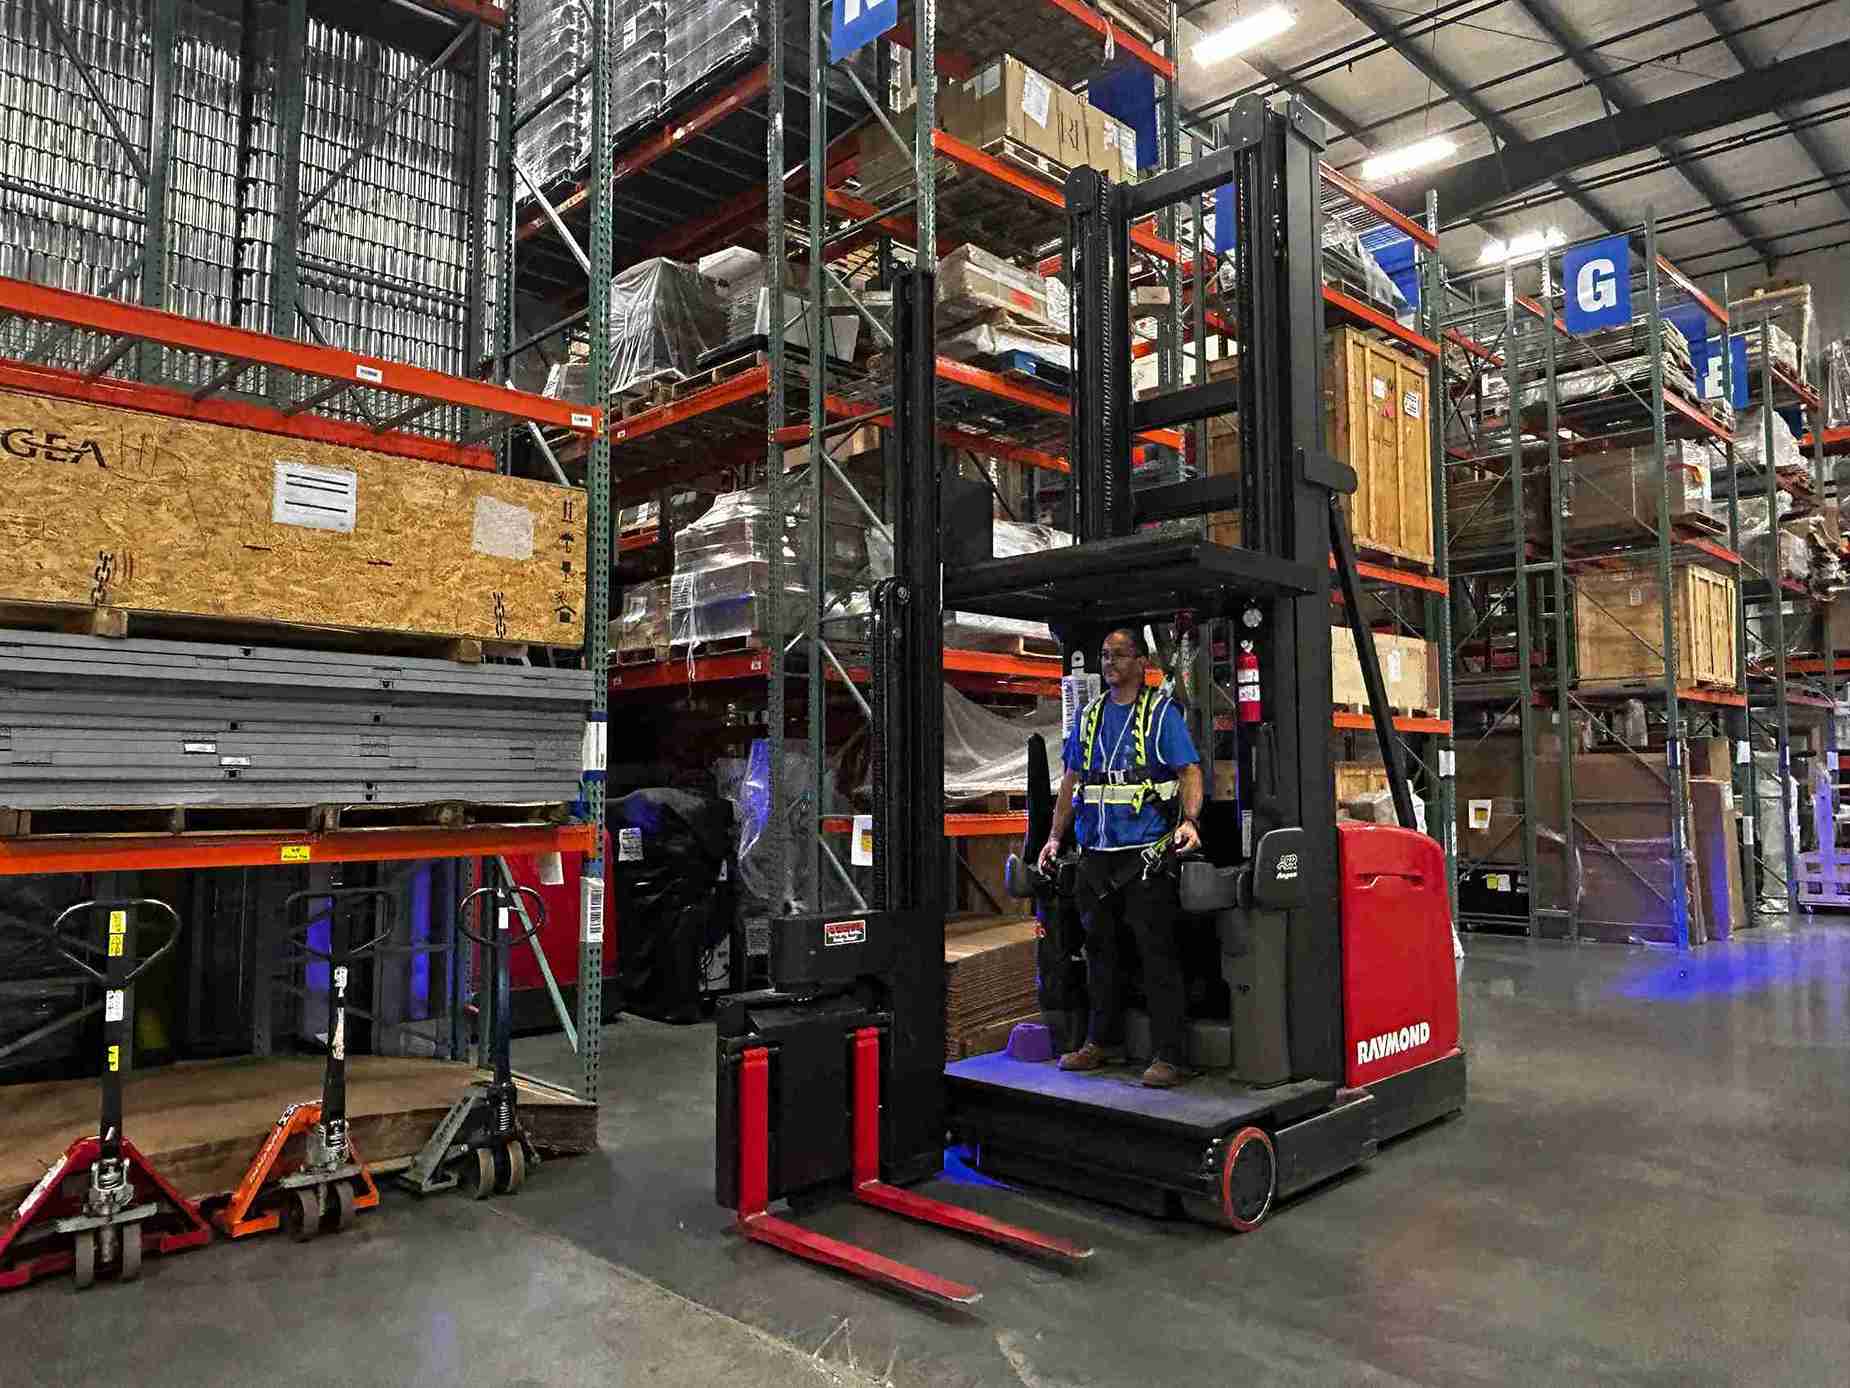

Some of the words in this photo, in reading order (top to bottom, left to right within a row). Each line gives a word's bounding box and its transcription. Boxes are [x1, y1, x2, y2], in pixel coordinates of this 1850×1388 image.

[1577, 258, 1617, 312] G
[0, 427, 107, 469] GEA
[1357, 1022, 1430, 1065] RAYMOND
